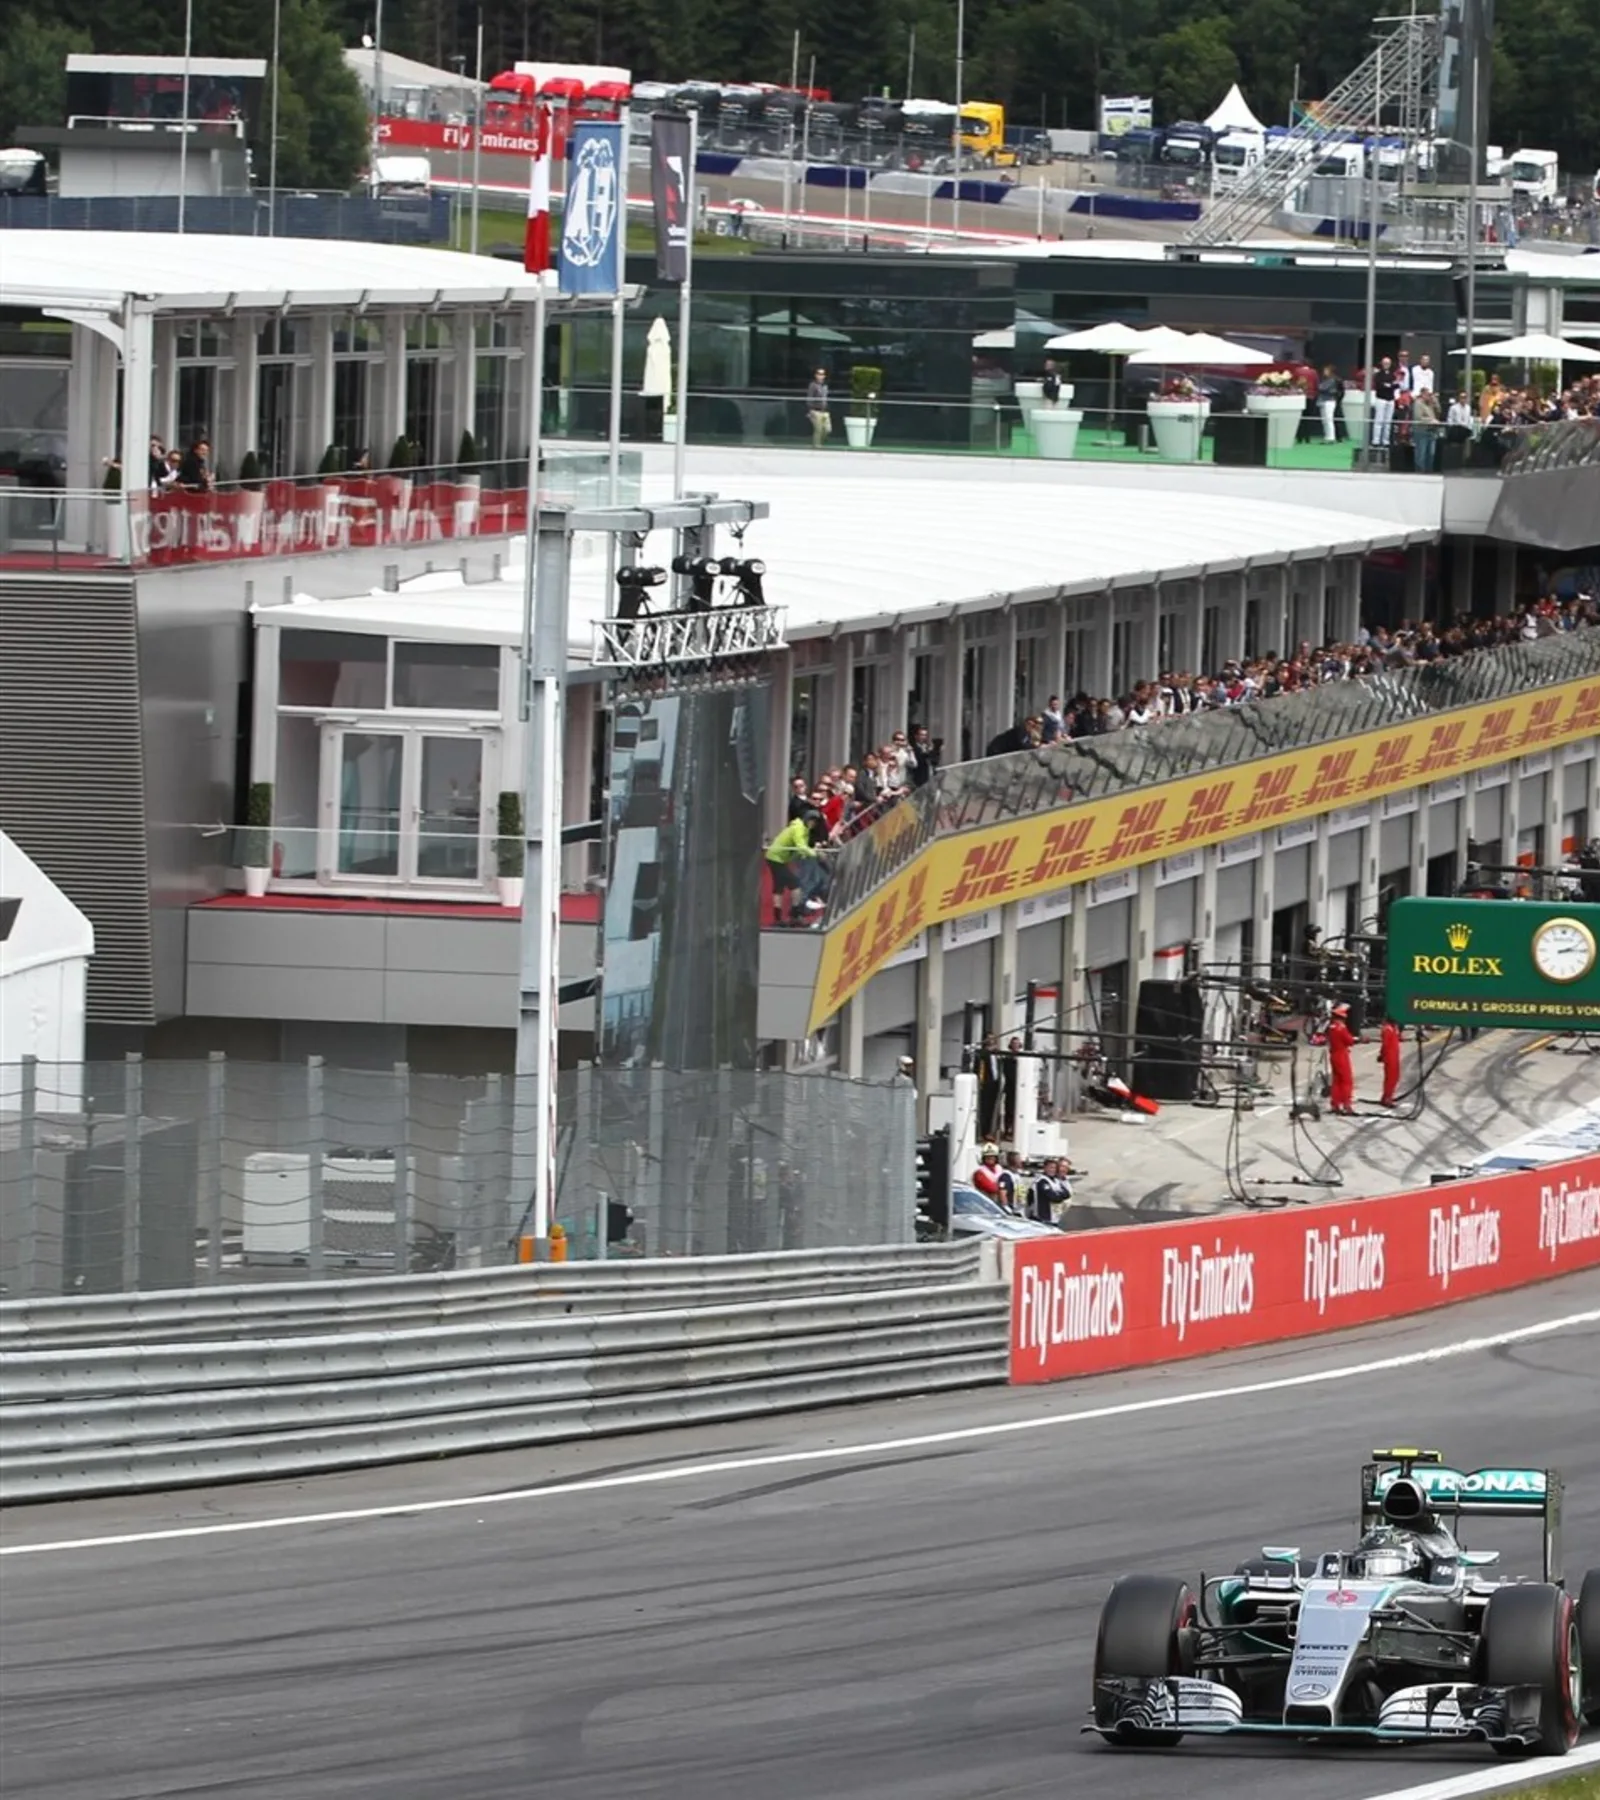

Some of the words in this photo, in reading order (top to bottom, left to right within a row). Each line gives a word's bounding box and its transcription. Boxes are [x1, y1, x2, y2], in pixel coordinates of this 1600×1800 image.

[1413, 956, 1503, 976] ROLEX
[1413, 999, 1469, 1011] FORMULA
[1472, 1002, 1478, 1012] 1
[1482, 1003, 1536, 1014] GROSSER
[1540, 1005, 1573, 1016] PREIS
[1577, 1006, 1600, 1017] VON
[1429, 1207, 1451, 1290] Fly
[1451, 1198, 1500, 1270] Emirates
[1539, 1185, 1560, 1262] Fly
[1162, 1249, 1189, 1341] Fly
[1190, 1237, 1254, 1321] Emirates
[1304, 1228, 1328, 1315] Fly
[1329, 1218, 1385, 1298] Emirates
[1020, 1264, 1050, 1366] Fly
[1052, 1254, 1124, 1345] Emirates
[1379, 1472, 1547, 1493] PTRONAS
